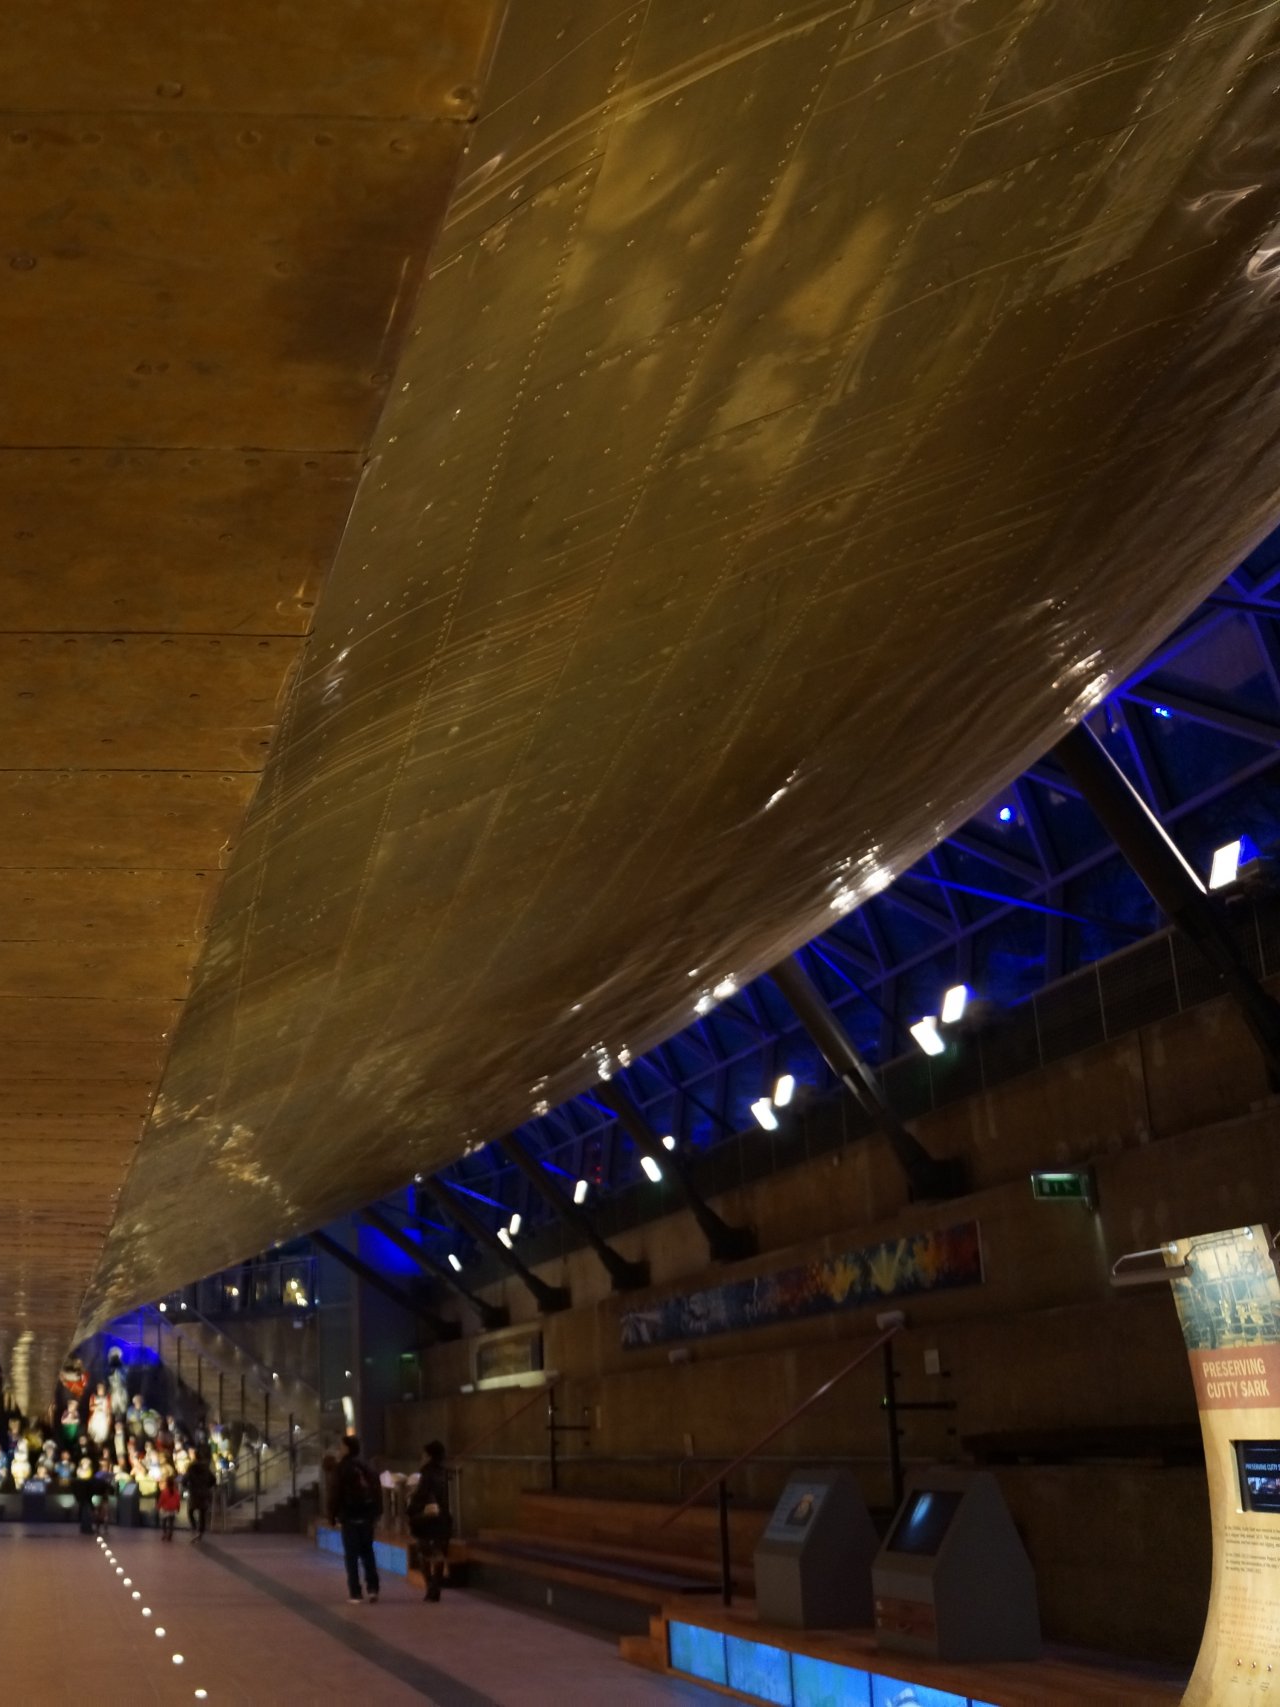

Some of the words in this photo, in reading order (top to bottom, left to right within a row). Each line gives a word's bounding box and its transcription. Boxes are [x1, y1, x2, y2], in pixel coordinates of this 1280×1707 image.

[1202, 1358, 1266, 1378] PRESERVING
[1206, 1381, 1239, 1399] CUTTY
[1240, 1379, 1270, 1398] SARK
